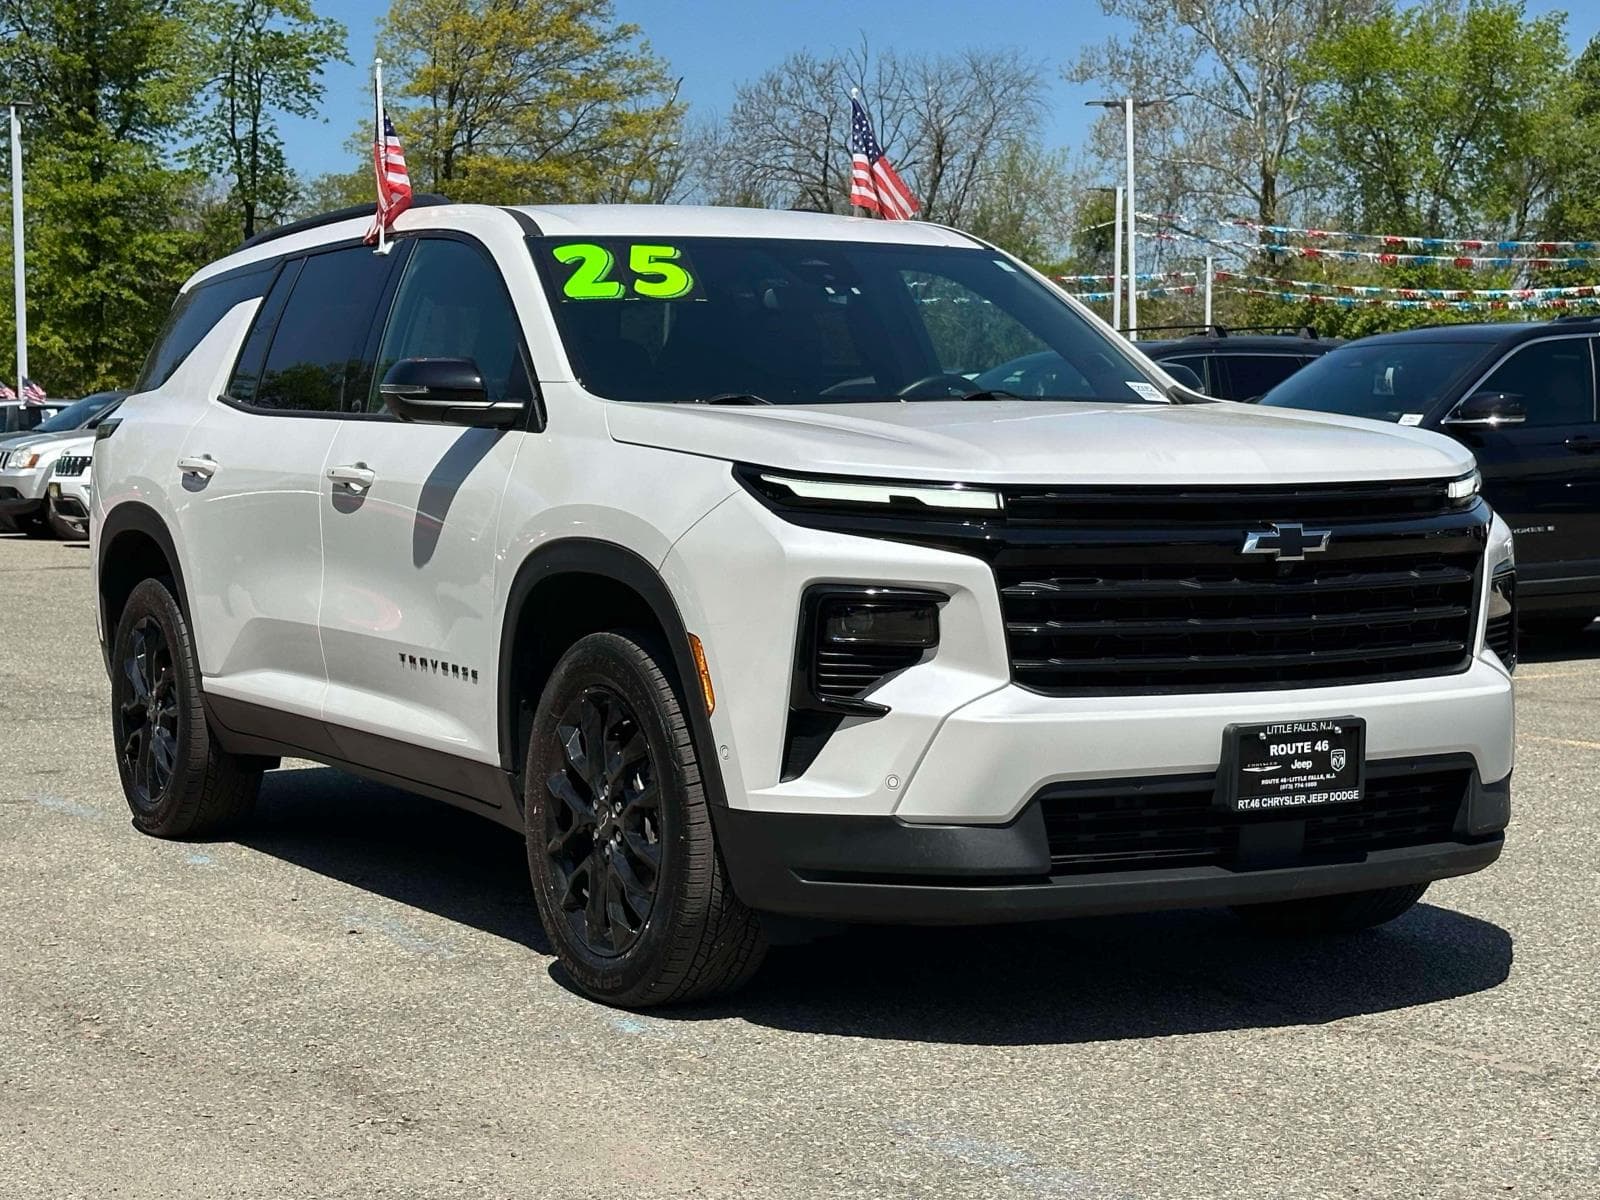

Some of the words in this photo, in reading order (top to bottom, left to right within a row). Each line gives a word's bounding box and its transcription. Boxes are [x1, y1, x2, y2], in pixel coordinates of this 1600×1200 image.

[552, 243, 695, 300] 25
[398, 652, 479, 680] TRAVERSE
[1266, 723, 1292, 735] LITTLE
[1293, 721, 1319, 733] FALLS,
[1269, 741, 1312, 757] ROUTE
[1314, 740, 1329, 752] 46
[1290, 759, 1313, 770] Jeep
[1261, 794, 1306, 808] CHRYSLER
[1307, 792, 1329, 804] JEEP
[1329, 790, 1359, 802] DODGE
